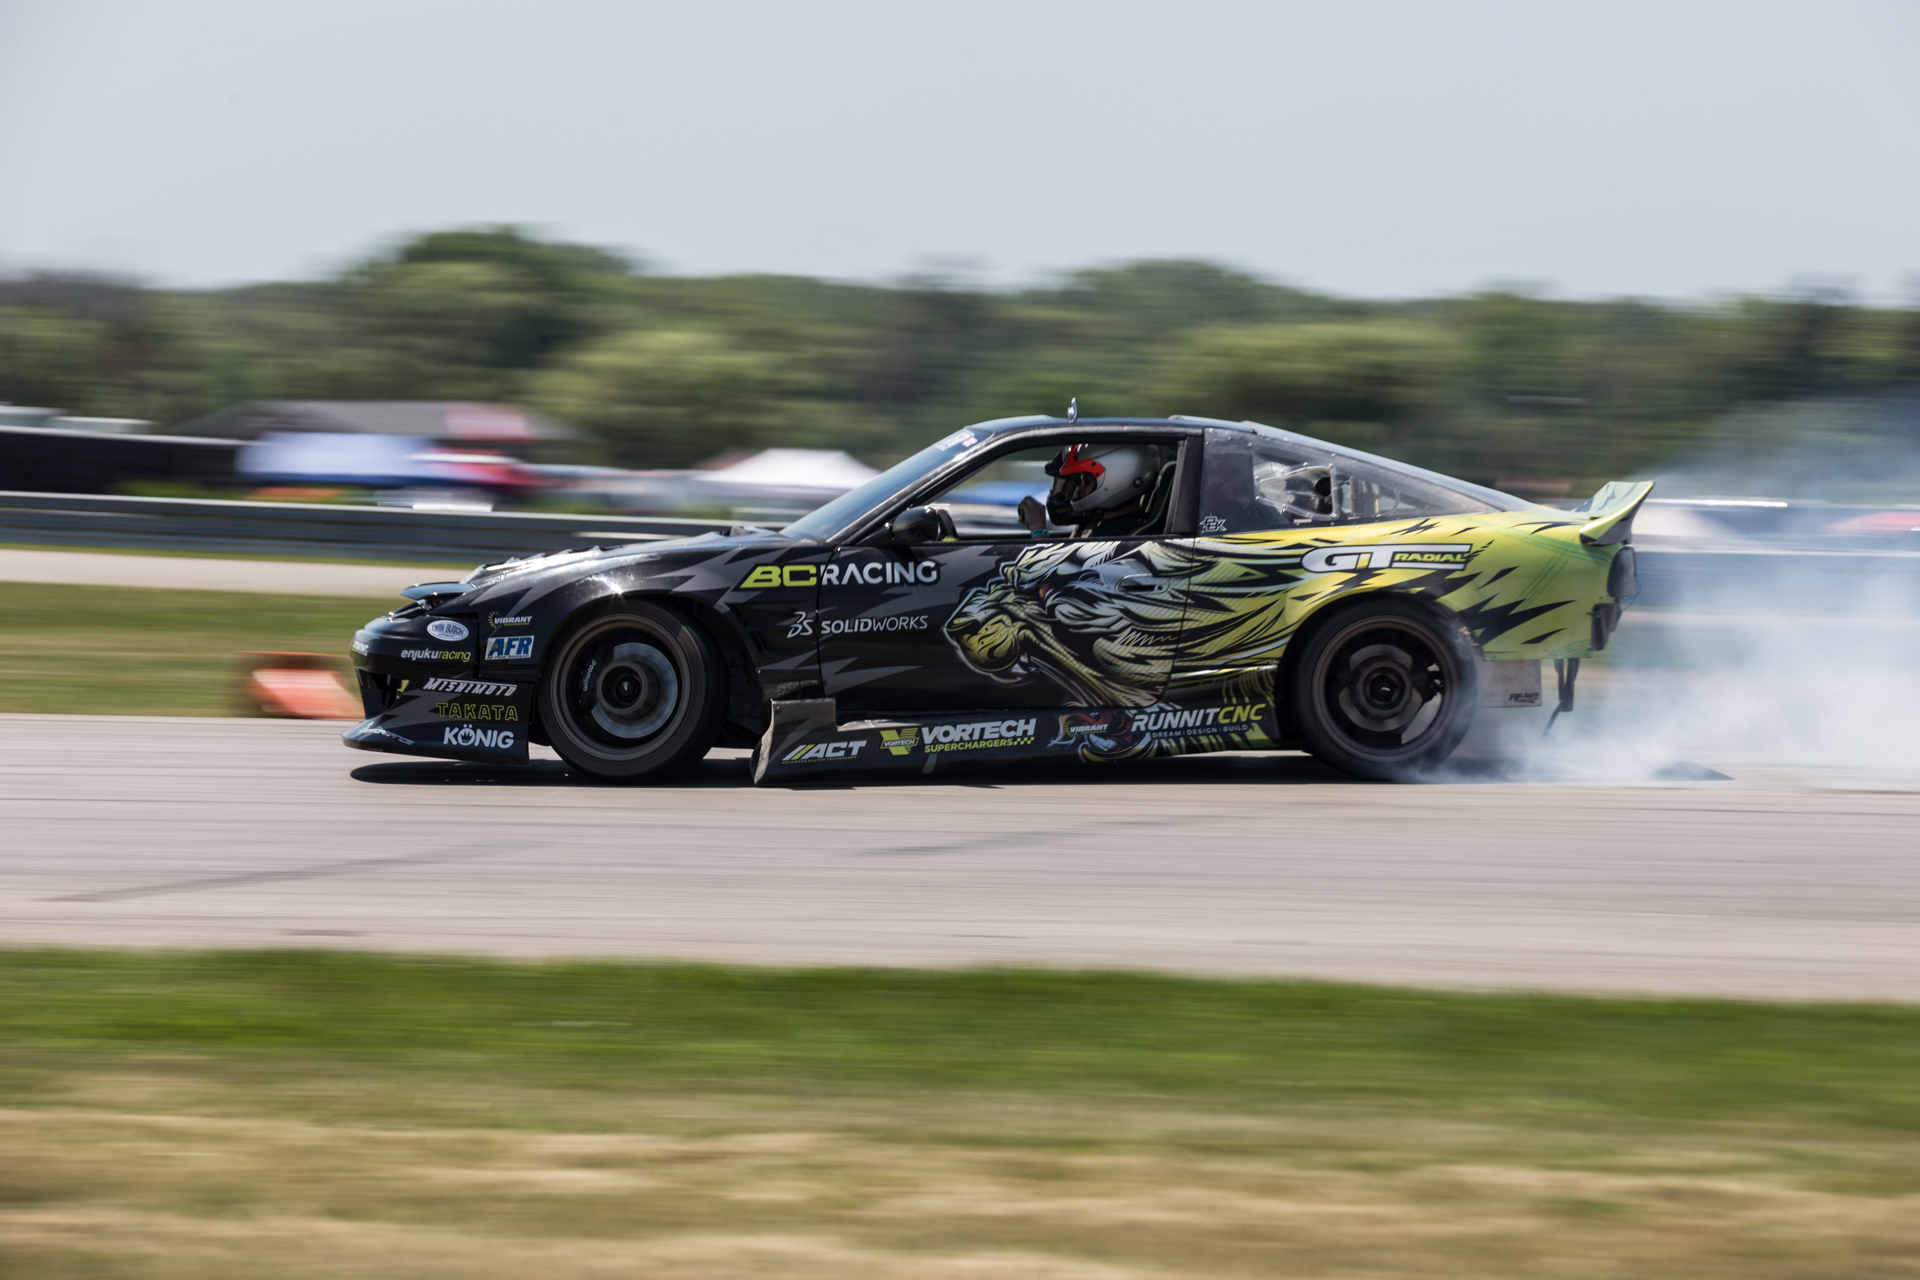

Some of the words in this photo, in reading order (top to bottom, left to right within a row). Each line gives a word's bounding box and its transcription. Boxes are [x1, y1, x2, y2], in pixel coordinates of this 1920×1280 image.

[1394, 553, 1466, 563] RADIAL
[494, 616, 532, 625] VIBRANT
[821, 615, 929, 634] SOLIDWORKS
[488, 637, 532, 656] AFR
[400, 648, 471, 663] enjukuracing
[583, 659, 597, 691] wilwood
[422, 677, 517, 697] MISHIMOTO
[436, 702, 518, 721] TAKATA
[443, 723, 514, 749] KÖNIG
[922, 718, 1037, 745] VORTECH
[1070, 723, 1109, 733] VIBRANT
[1152, 730, 1181, 739] DREAM
[1186, 727, 1218, 735] DESIGN
[1222, 724, 1248, 732] BUILD
[884, 739, 916, 747] VORTECH
[924, 738, 1013, 754] SUPERCHARGERS
